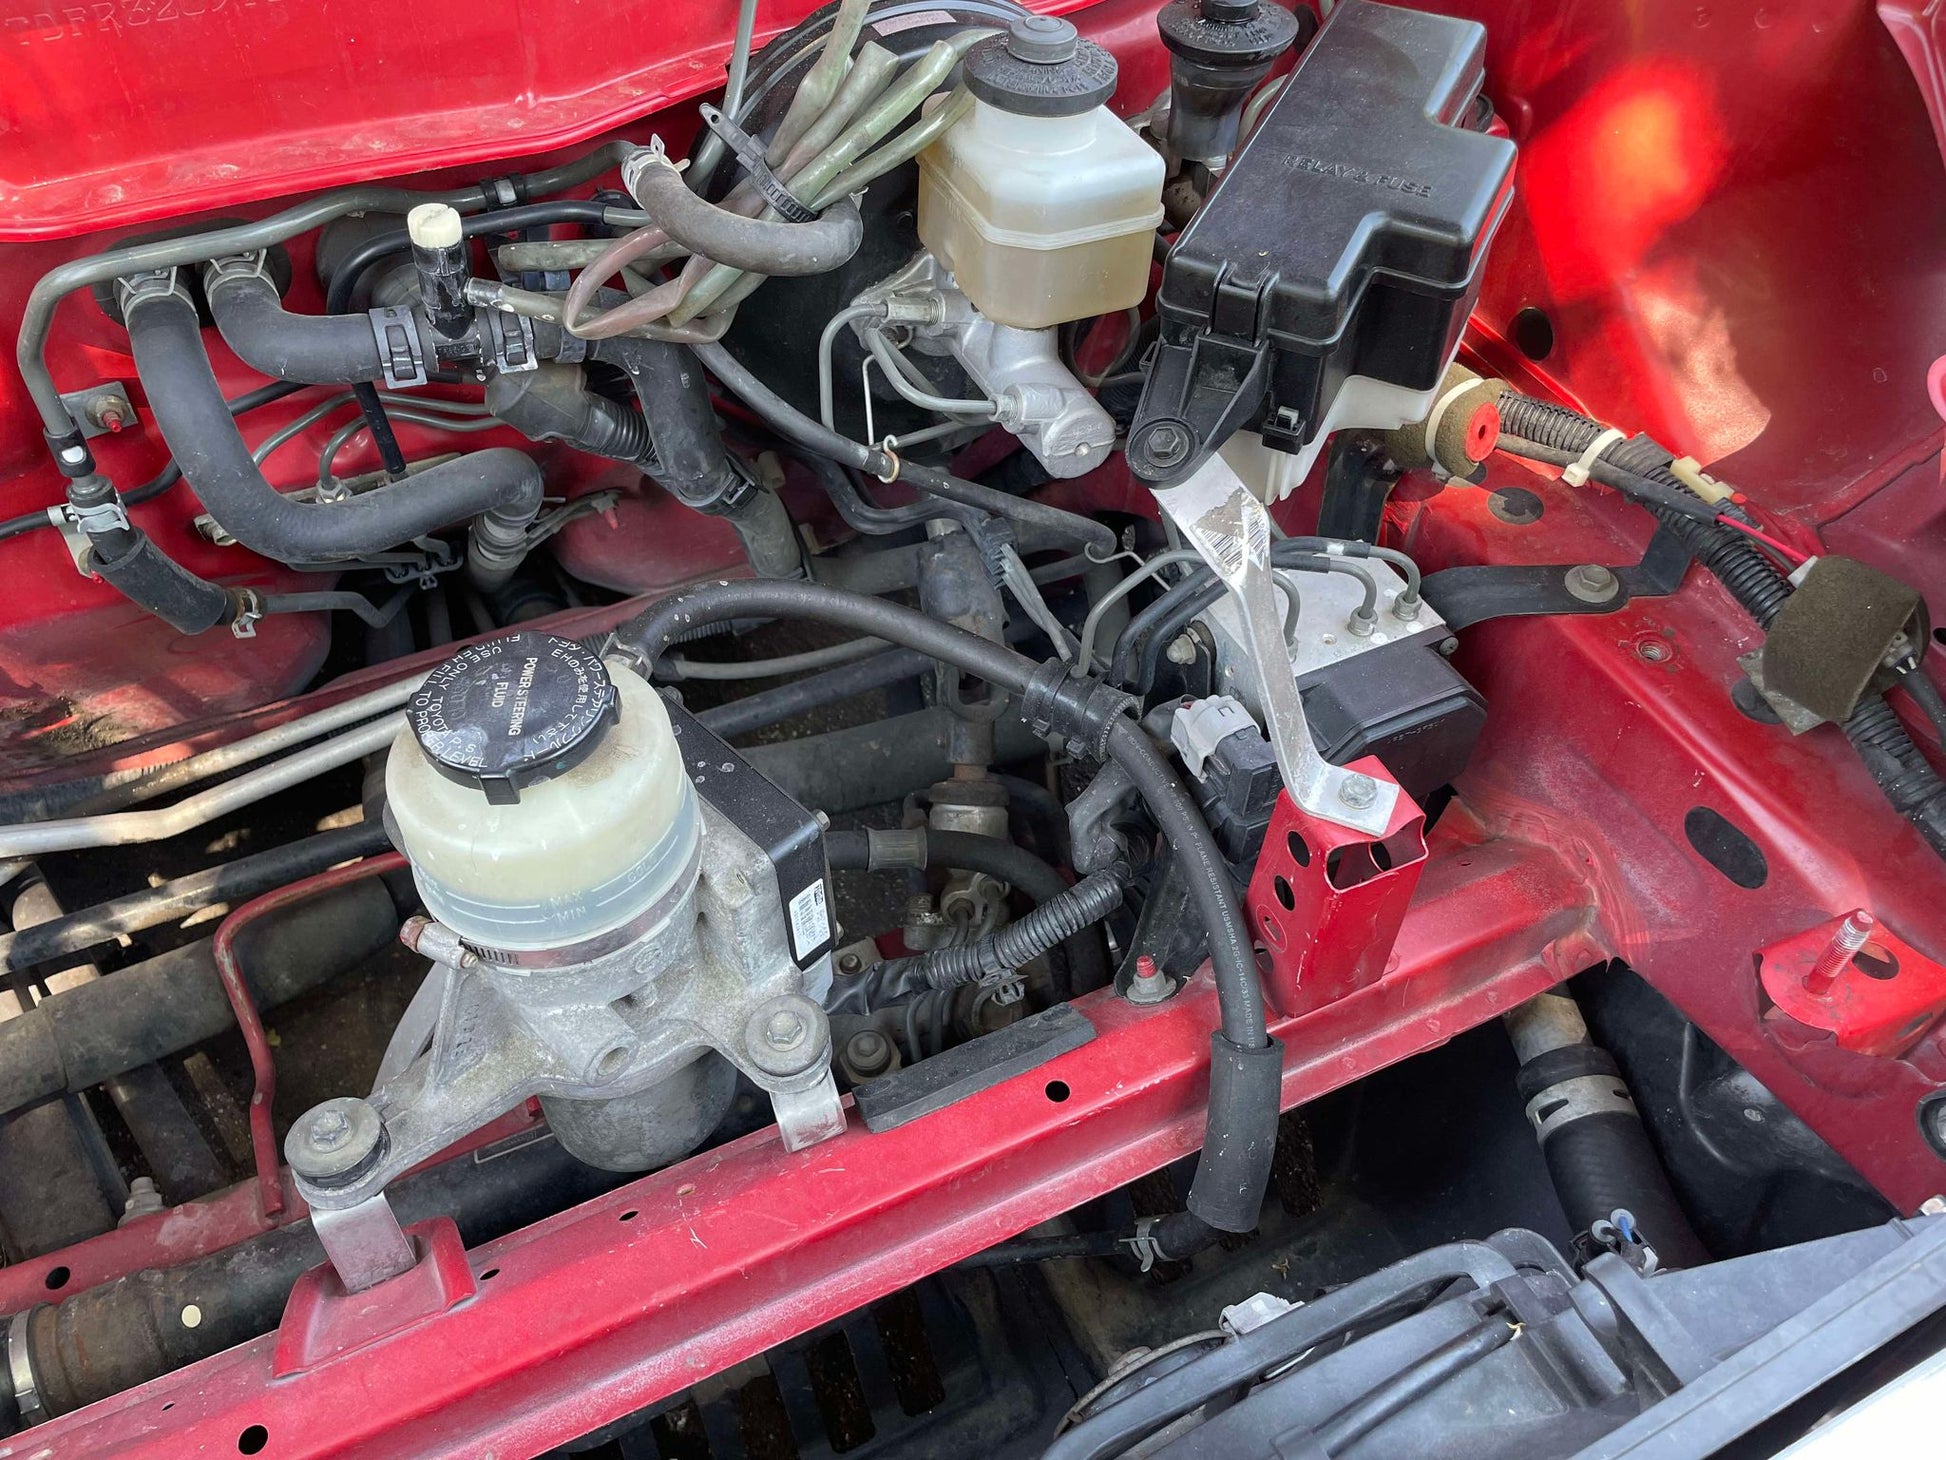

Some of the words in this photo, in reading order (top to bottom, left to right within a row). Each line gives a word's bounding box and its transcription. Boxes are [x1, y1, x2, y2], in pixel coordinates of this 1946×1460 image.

[1282, 153, 1354, 178] RELAY
[1352, 169, 1369, 184] &
[1374, 174, 1434, 199] FUSE
[468, 646, 503, 664] USE
[440, 663, 468, 691] ONLY
[519, 657, 538, 691] POWER
[491, 681, 509, 708] FLUID
[427, 695, 452, 739] TOYOTA
[508, 690, 529, 736] STEERING
[415, 690, 432, 707] TO
[443, 746, 488, 767] LEVEL
[1195, 842, 1210, 868] FLAME
[549, 890, 584, 907] MAX
[1206, 867, 1228, 909] RESISTANT
[556, 905, 588, 922] MIN
[1243, 1000, 1253, 1026] MADE
[1246, 1026, 1253, 1035] IN
